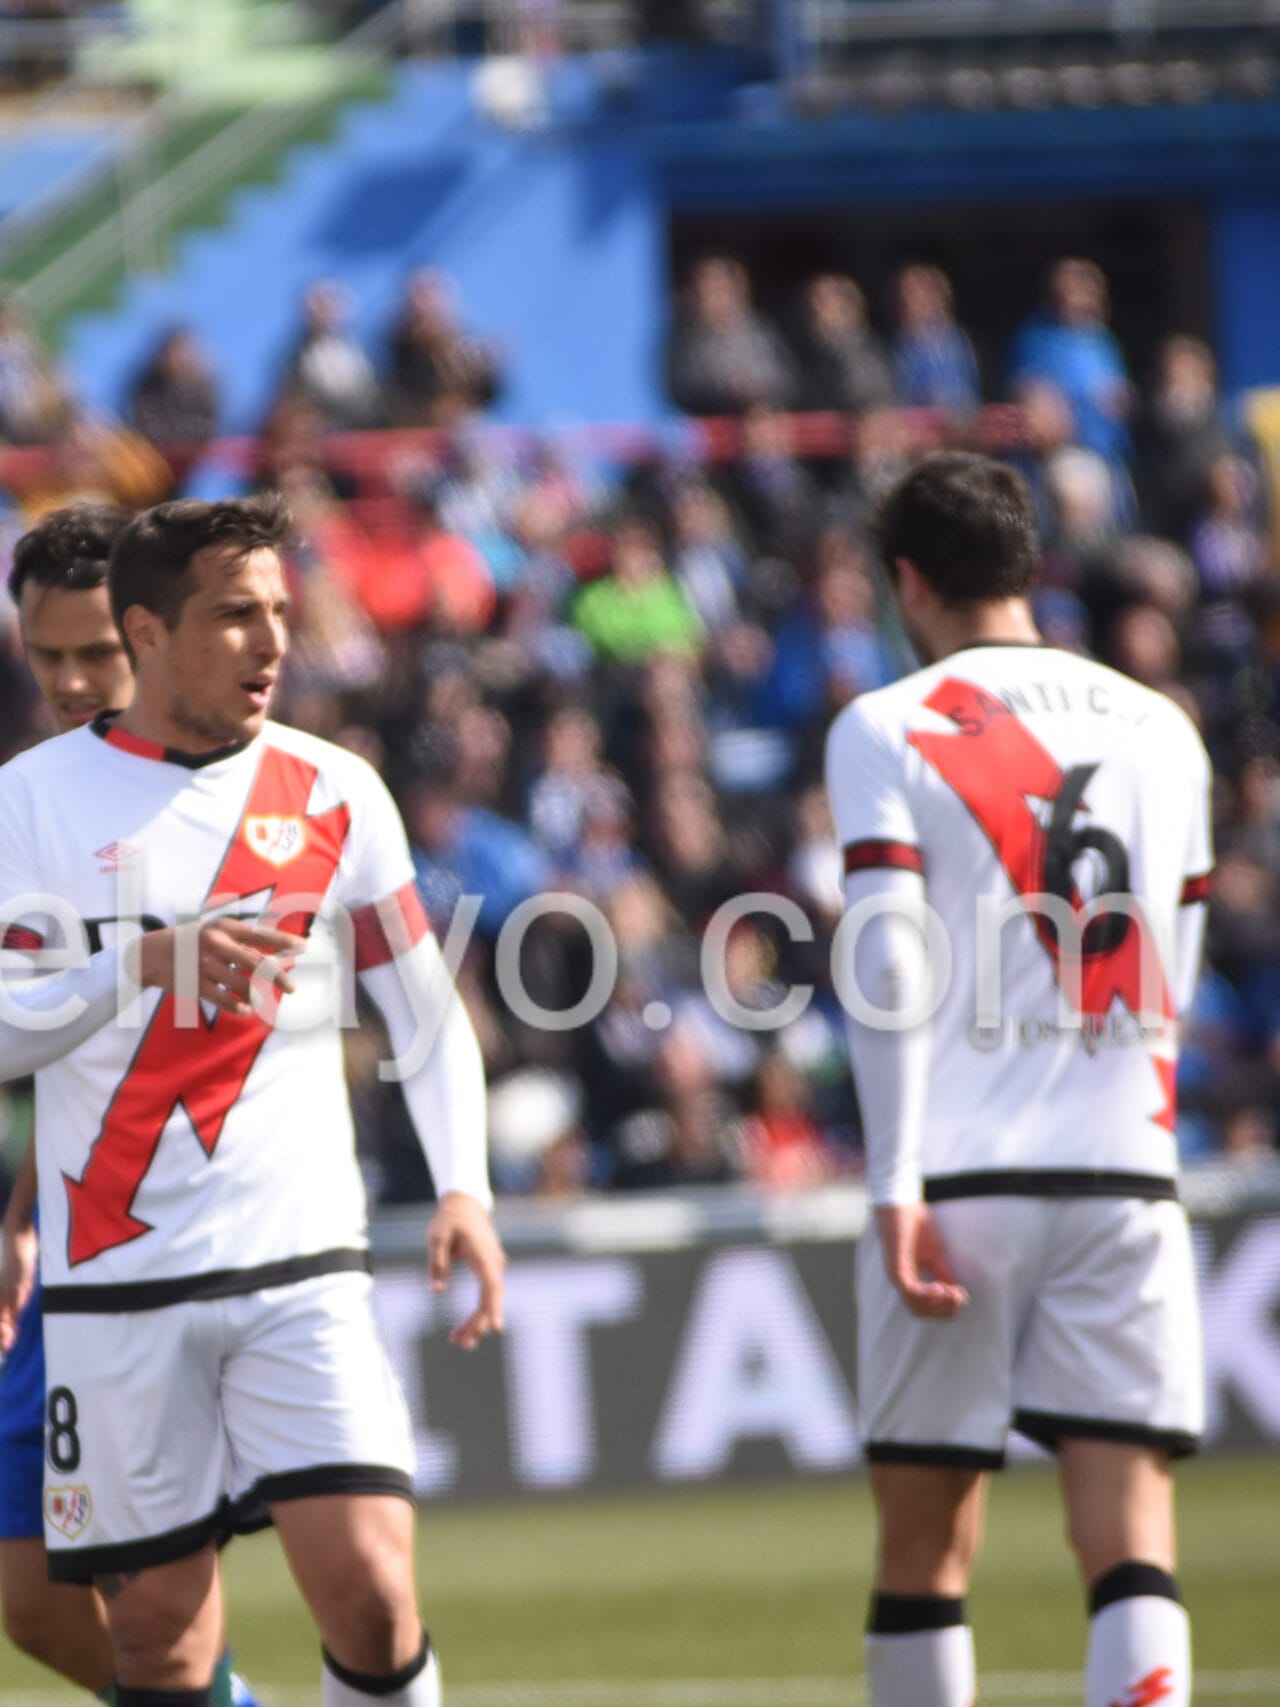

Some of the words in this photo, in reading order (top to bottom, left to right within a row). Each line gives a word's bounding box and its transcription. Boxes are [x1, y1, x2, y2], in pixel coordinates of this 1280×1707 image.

[949, 677, 1070, 736] SANTI
[1044, 762, 1131, 954] 6
[48, 1386, 81, 1474] 8
